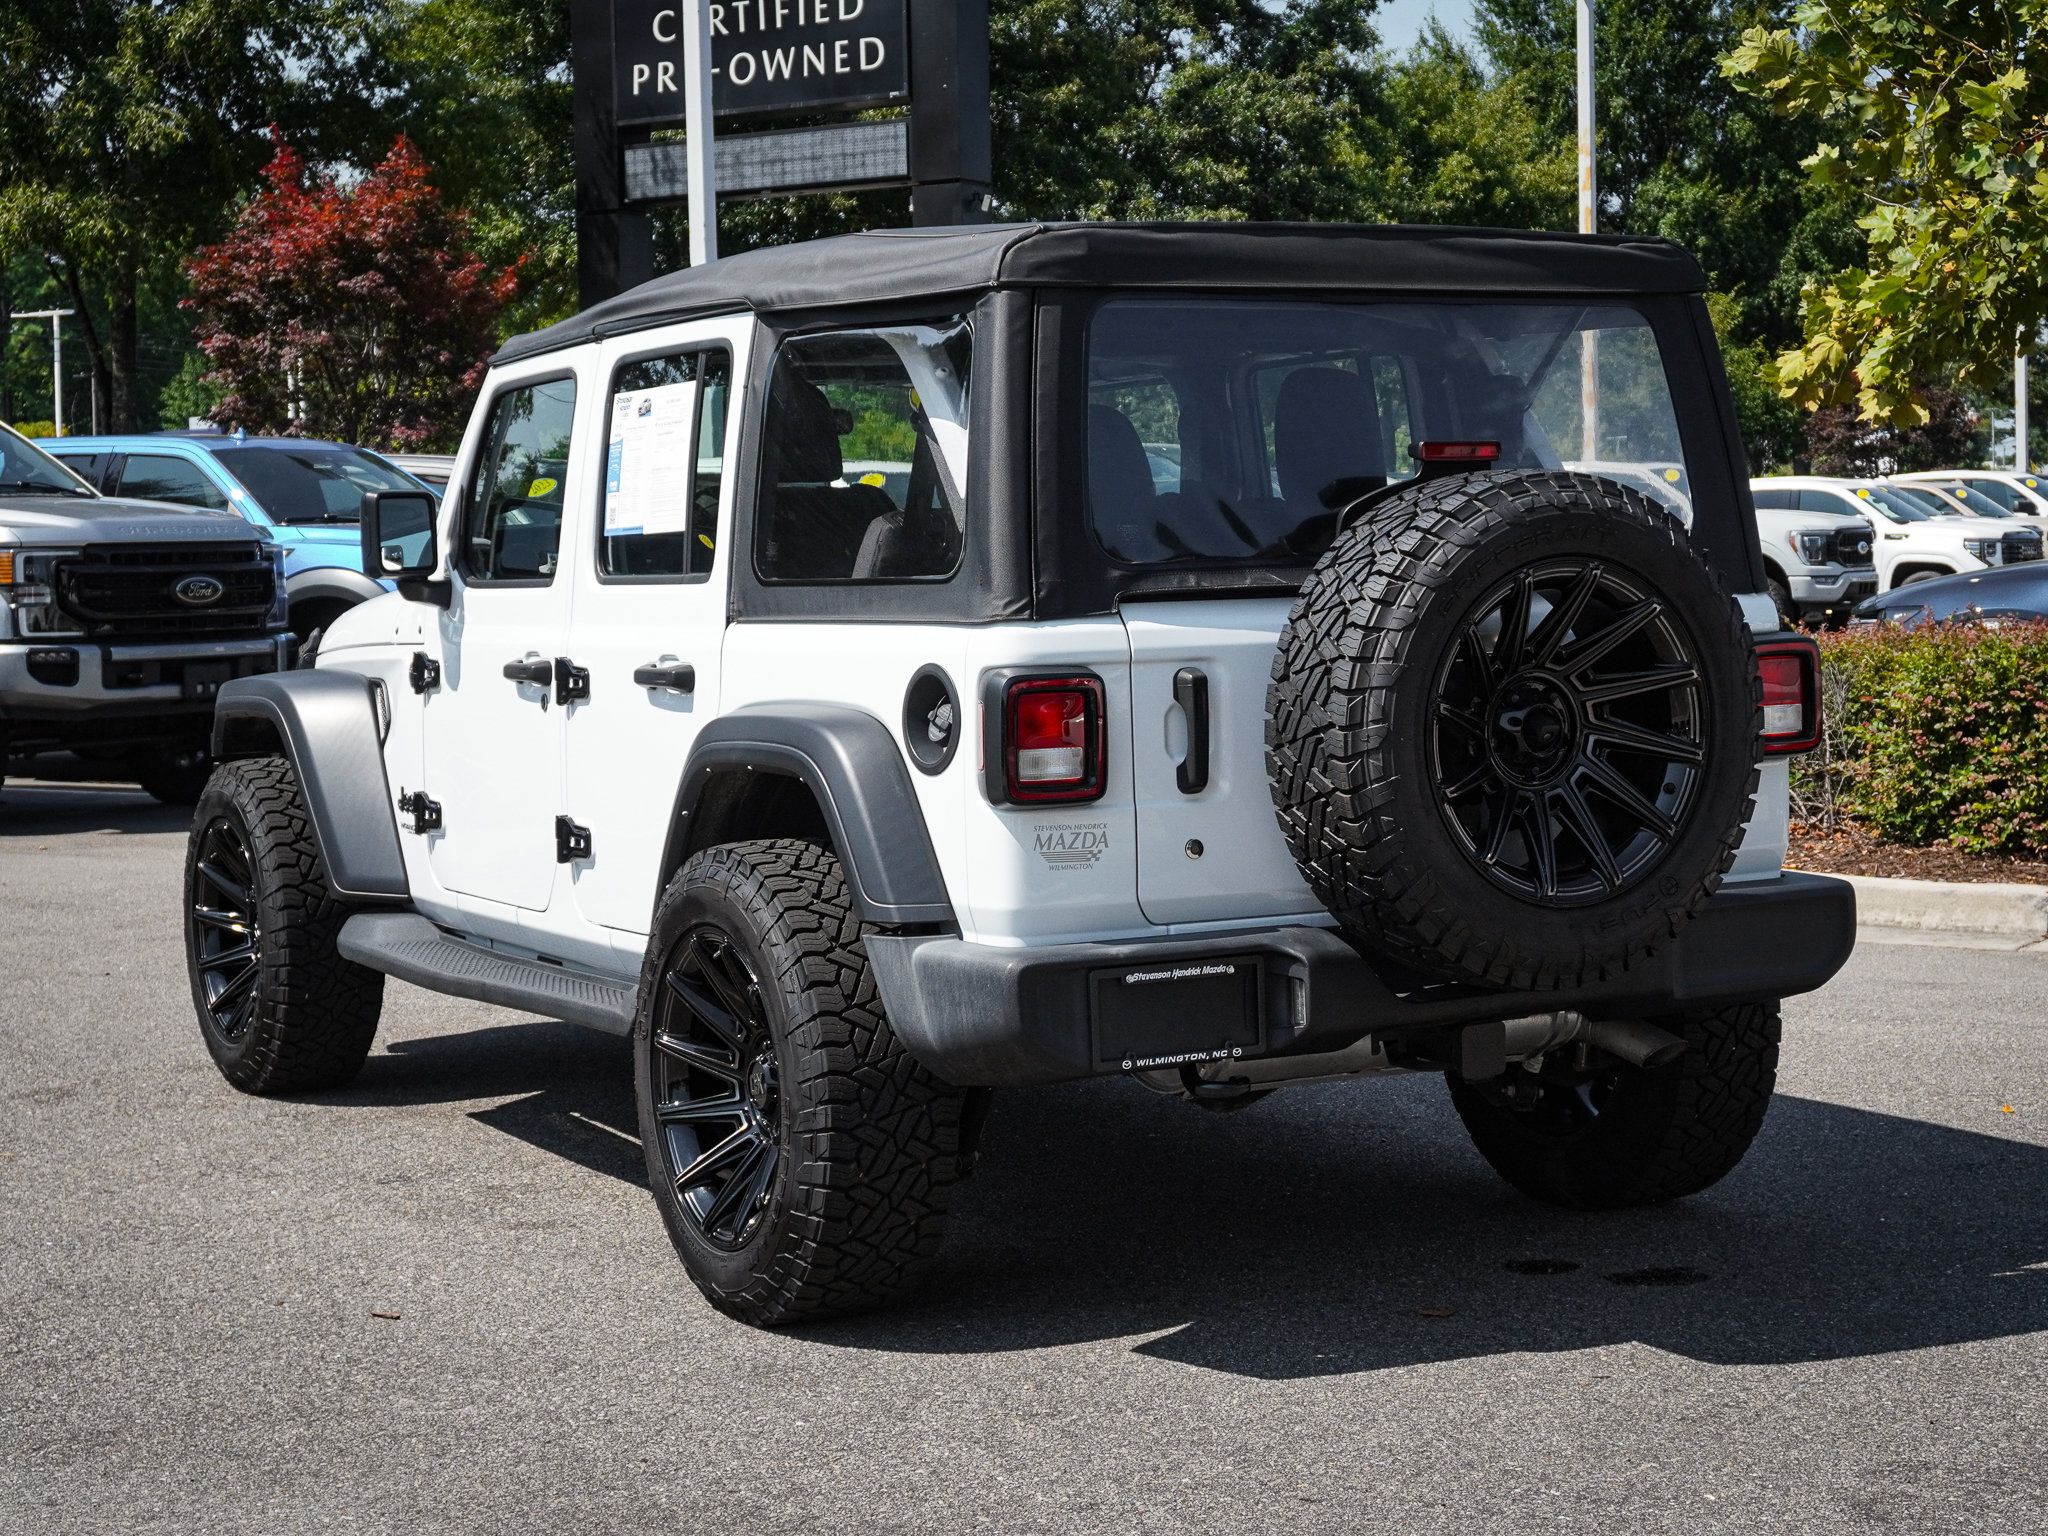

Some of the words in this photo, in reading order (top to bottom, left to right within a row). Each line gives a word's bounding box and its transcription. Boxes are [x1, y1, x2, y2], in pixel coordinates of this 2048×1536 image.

[652, 0, 863, 43] CRTIFIED
[632, 36, 885, 96] PR-OWNED
[1033, 824, 1073, 832] STEVENSON
[1073, 822, 1108, 831] HENDRICK
[1033, 830, 1109, 851] MAZDA
[1048, 863, 1094, 871] WILMINGTON
[1202, 964, 1227, 975] Mazda
[1136, 1052, 1209, 1067] WILMINGTON,
[1212, 1050, 1228, 1058] NC
